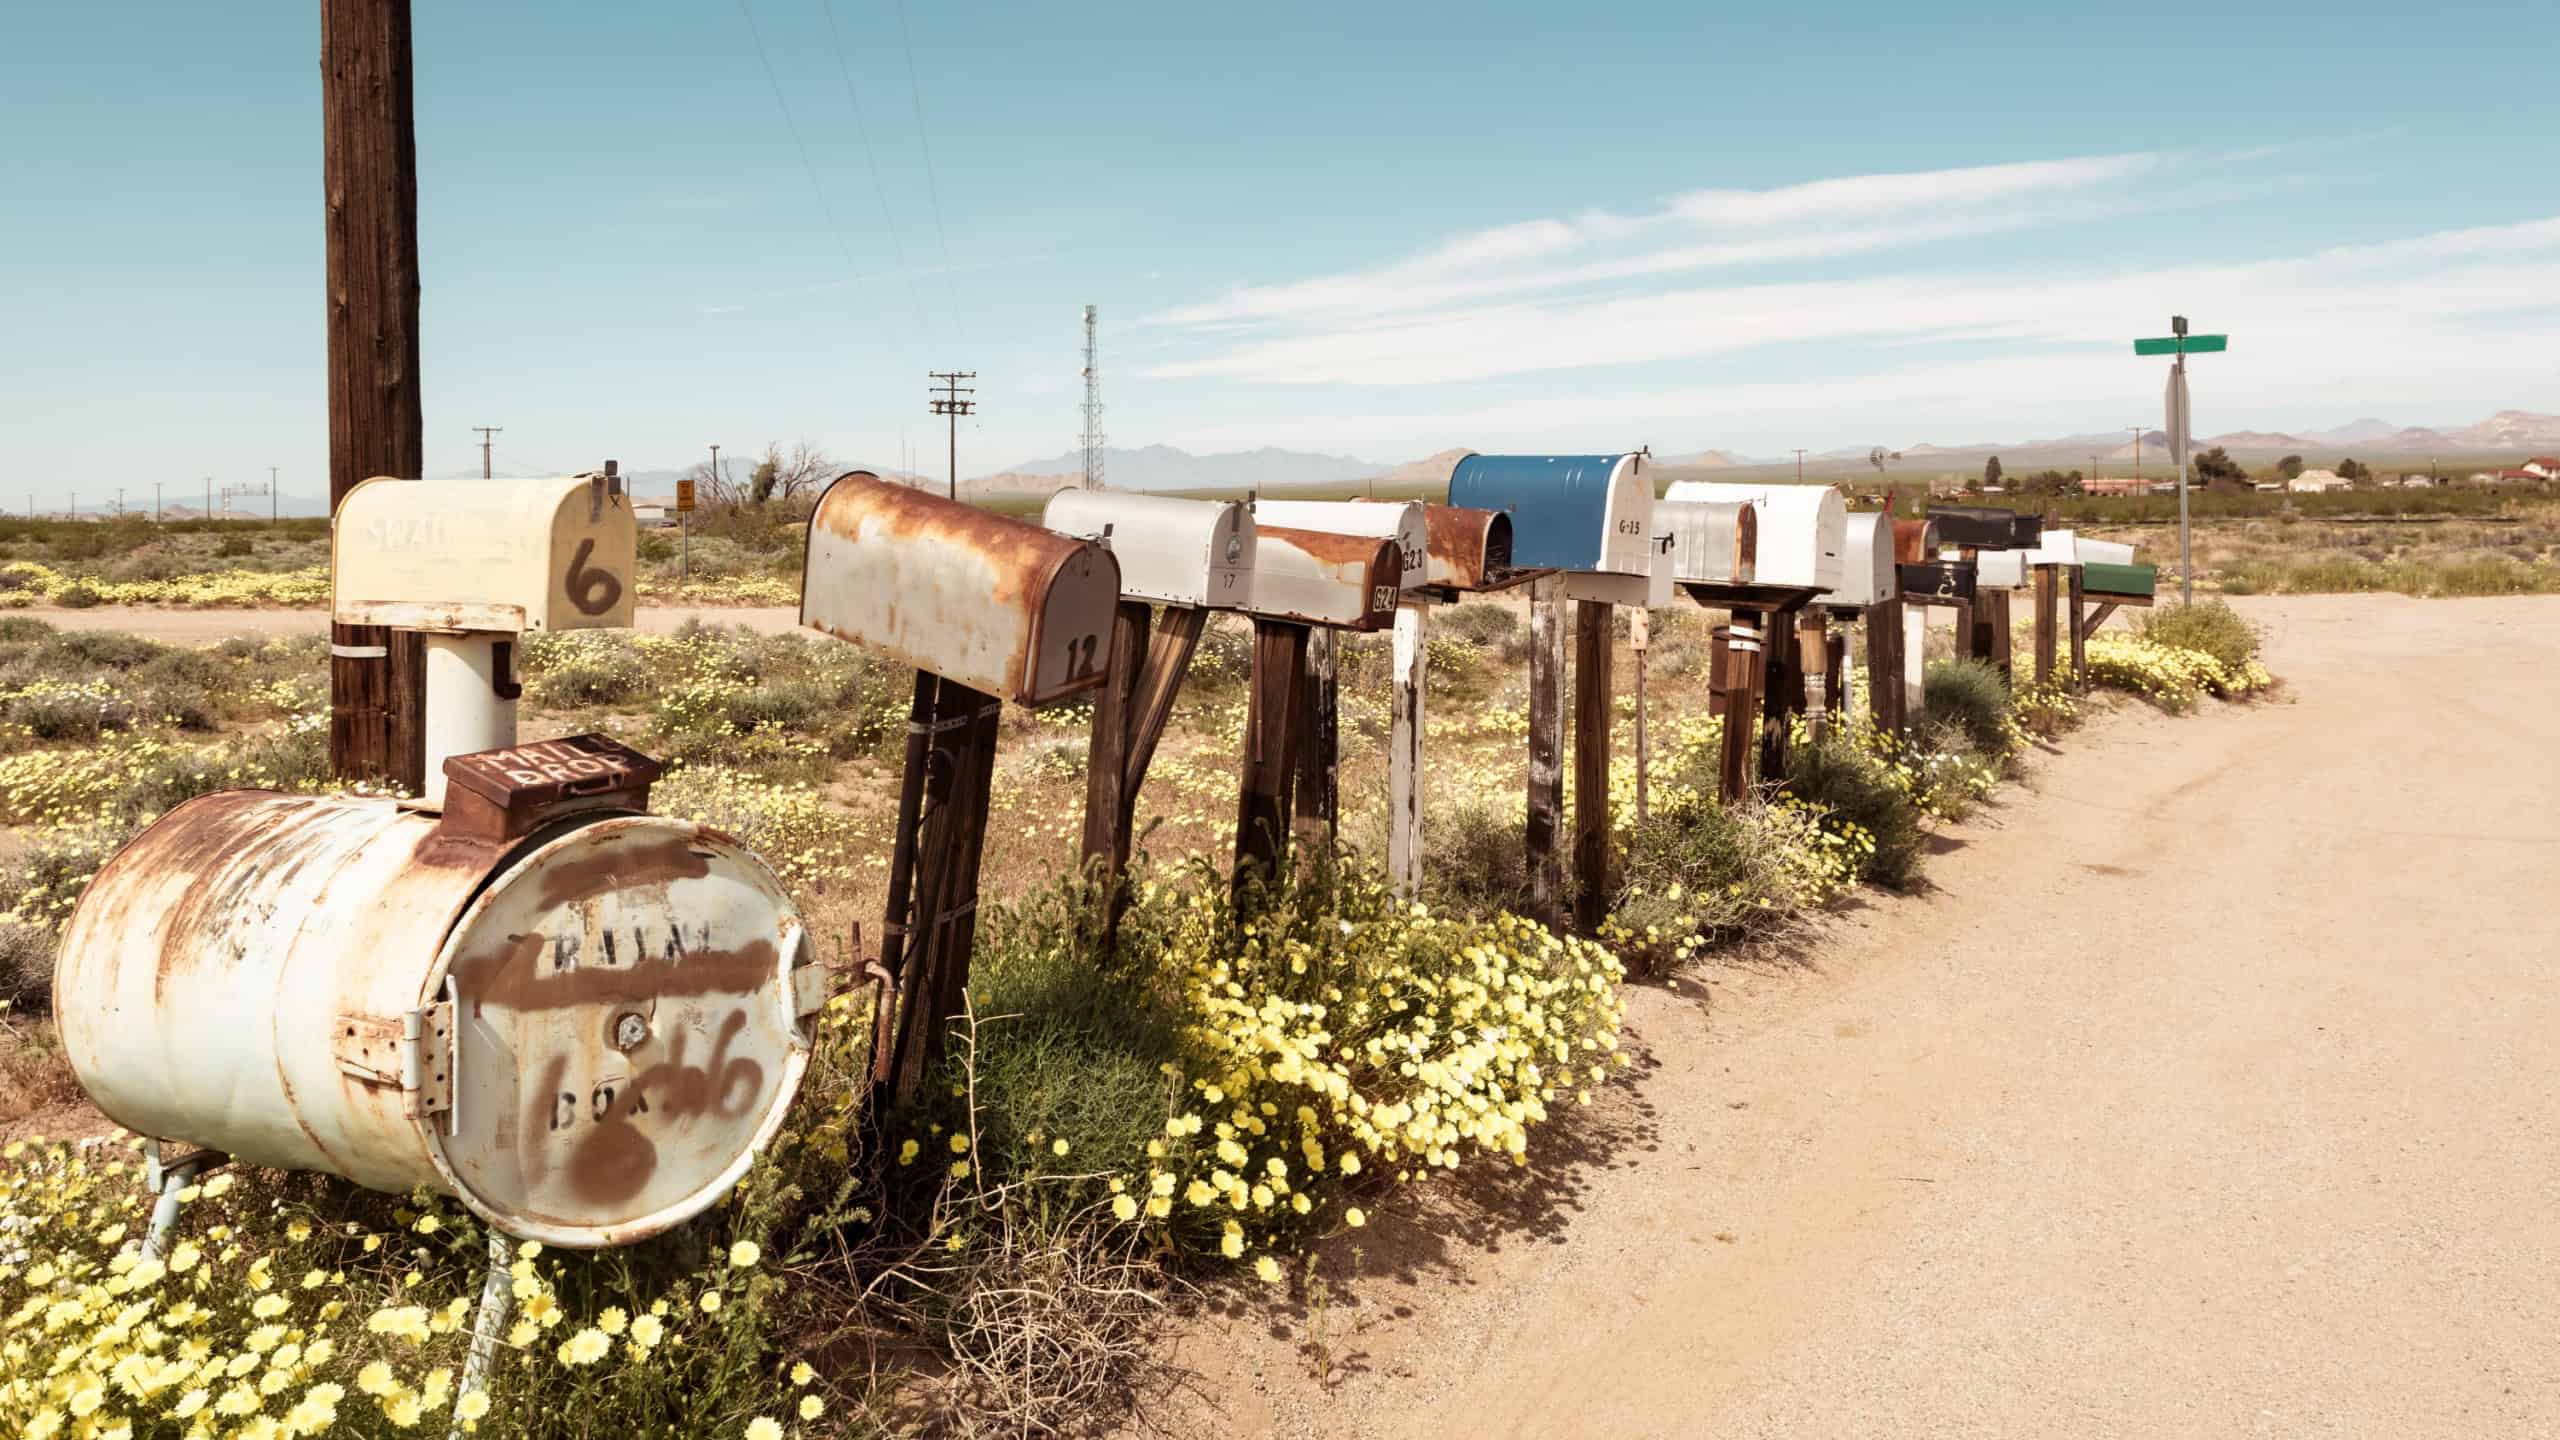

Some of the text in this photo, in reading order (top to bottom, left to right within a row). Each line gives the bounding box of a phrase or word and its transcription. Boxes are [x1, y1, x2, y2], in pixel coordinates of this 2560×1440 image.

[1402, 548, 1423, 572] G23
[565, 537, 622, 616] 6
[1223, 573, 1236, 589] 17
[1066, 633, 1098, 684] 12
[484, 743, 593, 771] MAIL
[504, 754, 628, 785] DROP
